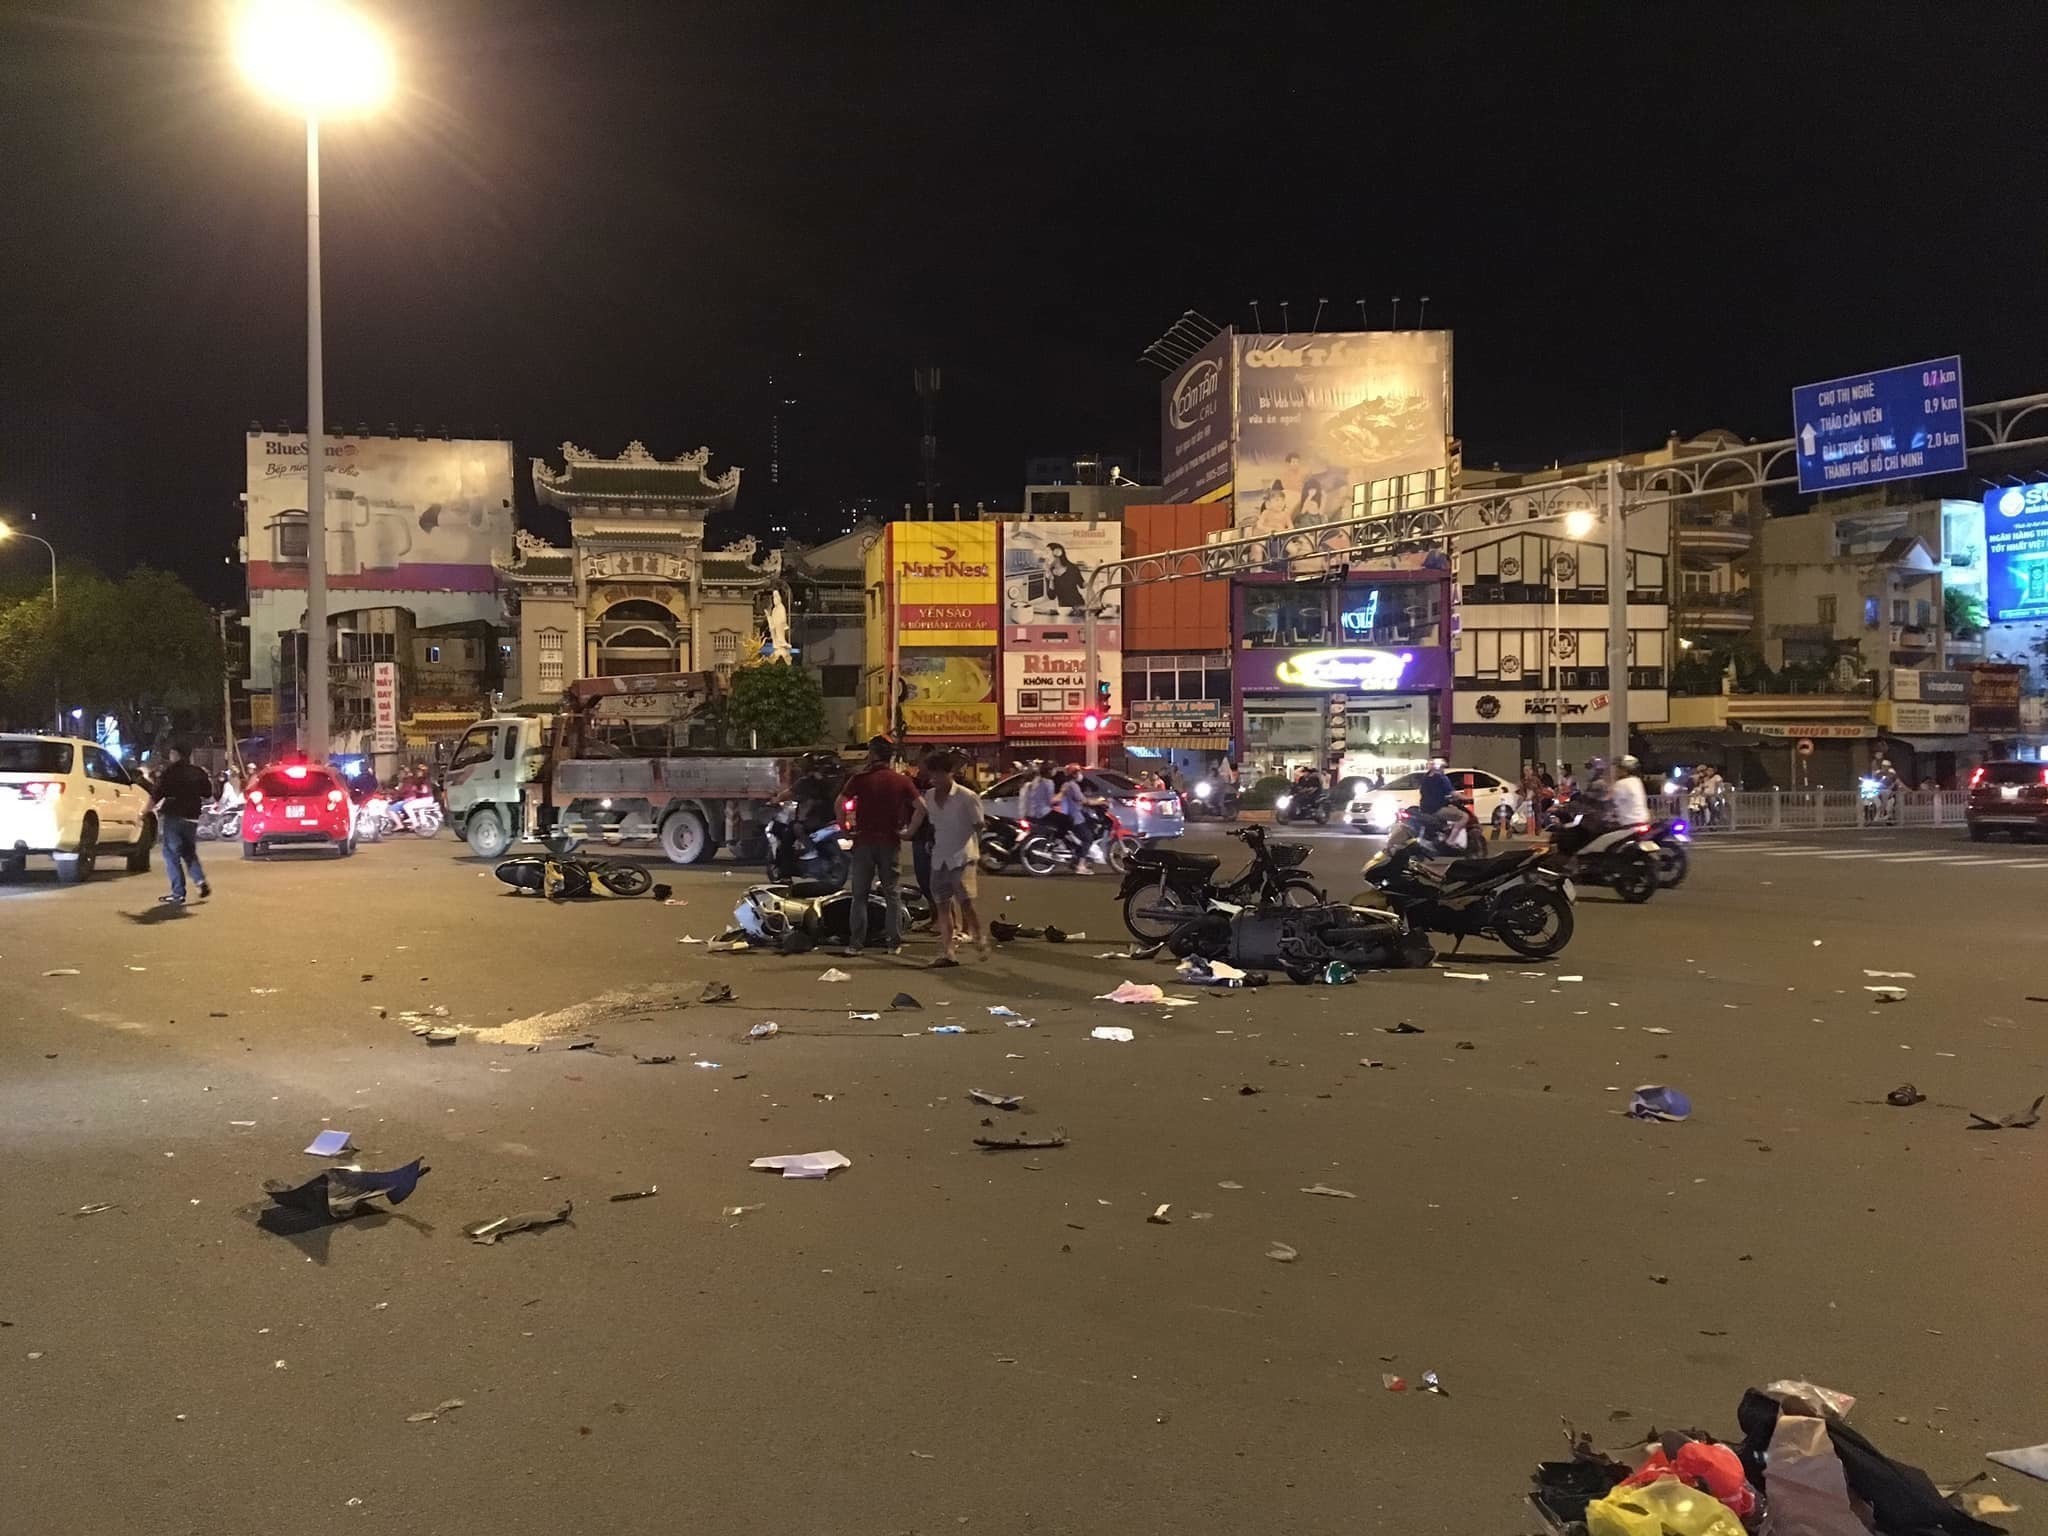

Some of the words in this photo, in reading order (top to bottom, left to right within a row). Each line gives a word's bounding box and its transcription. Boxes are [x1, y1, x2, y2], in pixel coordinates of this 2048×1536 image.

[1940, 369, 1956, 383] km
[1818, 391, 1835, 406] CHỢ
[1837, 388, 1850, 404] THỊ
[1852, 380, 1875, 400] NGHÈ
[1200, 399, 1217, 421] CALI
[1941, 397, 1957, 411] km
[1820, 411, 1842, 432] THẢO
[1843, 410, 1862, 429] CẦM
[1863, 406, 1883, 425] VIÊN
[1943, 431, 1960, 446] km
[265, 441, 343, 456] BlueSne
[1824, 460, 1851, 480] THÀNH
[1852, 456, 1869, 476] PHỐ
[1871, 455, 1883, 473] HỒ
[1884, 451, 1899, 470] CHÍ
[1900, 451, 1924, 469] MINH
[902, 561, 989, 577] NutriNest
[1023, 676, 1054, 686] KHÔNG
[1525, 704, 1588, 715] FACTORY
[1179, 721, 1193, 729] TEA
[1202, 721, 1231, 729] COFFEE
